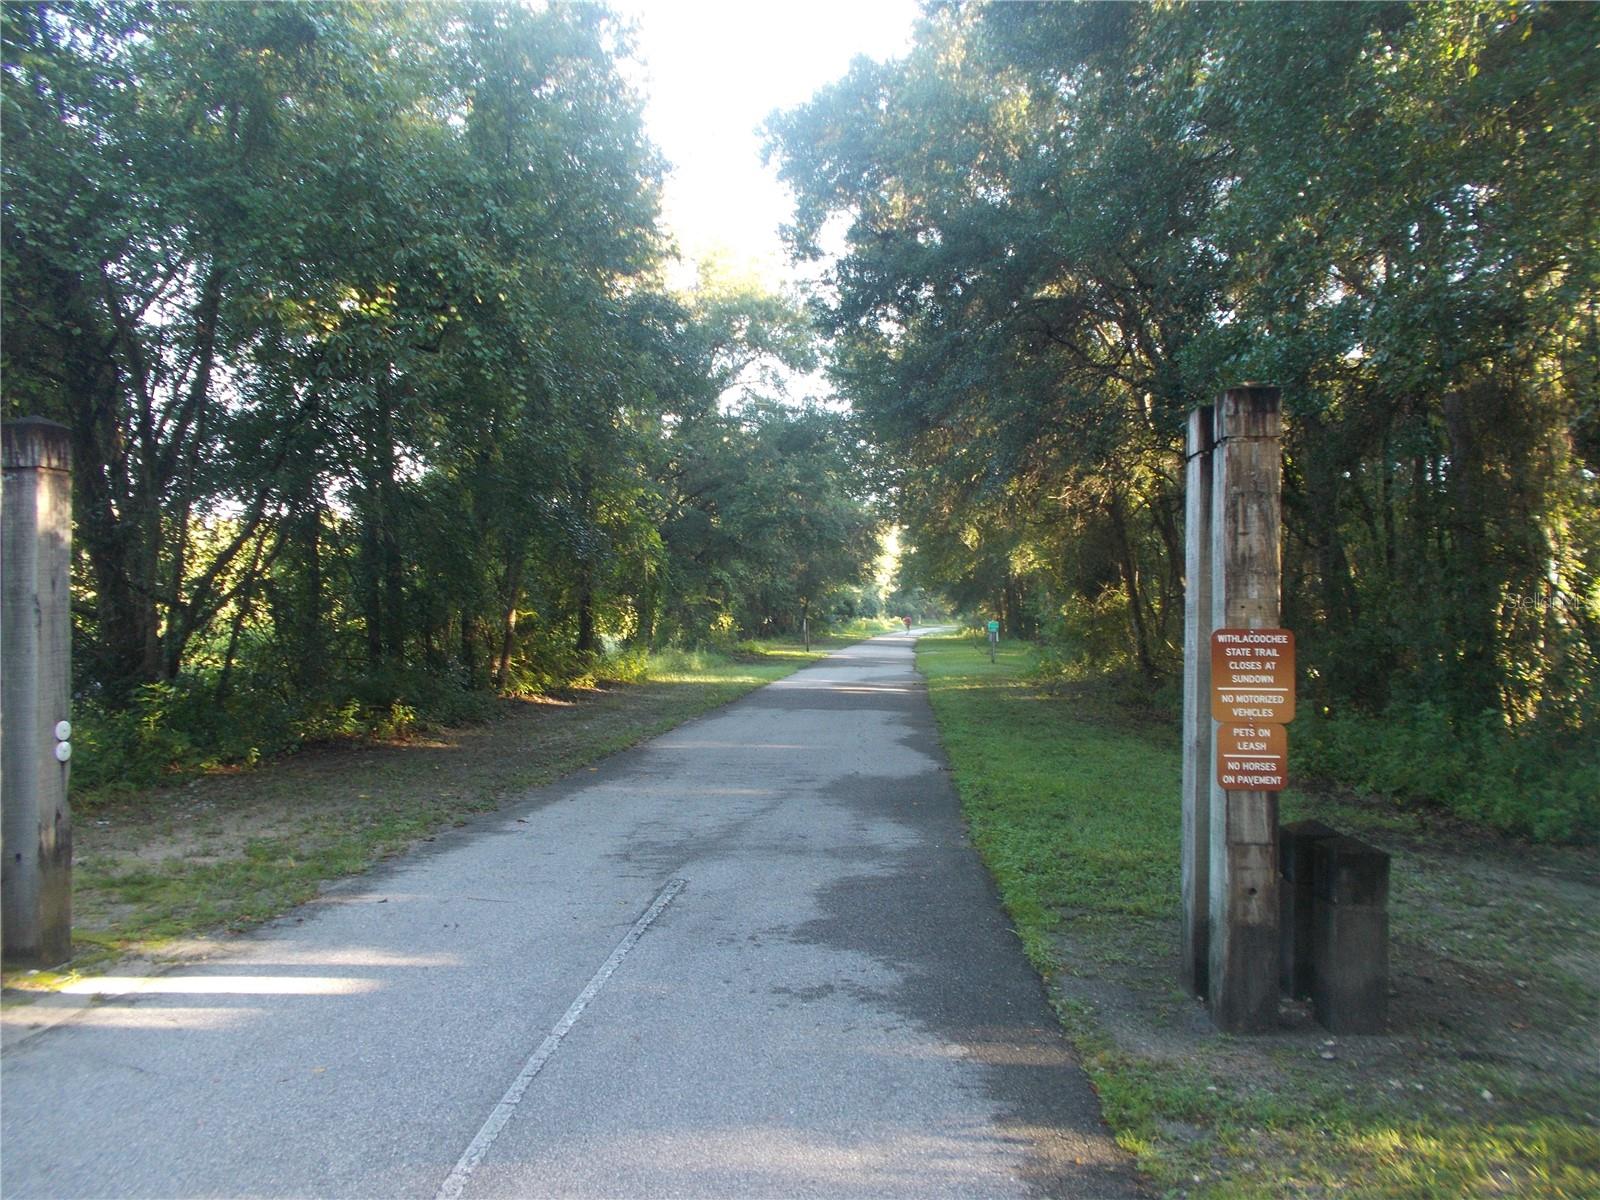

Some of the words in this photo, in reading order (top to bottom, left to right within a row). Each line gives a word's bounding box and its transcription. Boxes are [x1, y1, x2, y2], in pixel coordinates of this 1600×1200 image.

[1217, 634, 1288, 644] WITHLACOOCHEE
[1225, 648, 1251, 657] STATE
[1255, 648, 1280, 657] TRAIL
[1229, 662, 1262, 670] CLOSES
[1265, 662, 1277, 670] AT
[1232, 675, 1274, 684] SUNDOWN
[1221, 695, 1233, 703] NO
[1236, 695, 1284, 704] MOTORIZED
[1232, 709, 1274, 717] VEHICLES
[1233, 728, 1255, 737] PETS
[1258, 728, 1271, 737] ON
[1237, 742, 1267, 751] LEASH
[1227, 762, 1240, 771] NO
[1243, 762, 1277, 771] HORSES
[1222, 776, 1235, 784] ON
[1237, 776, 1282, 785] PAVEMENT
